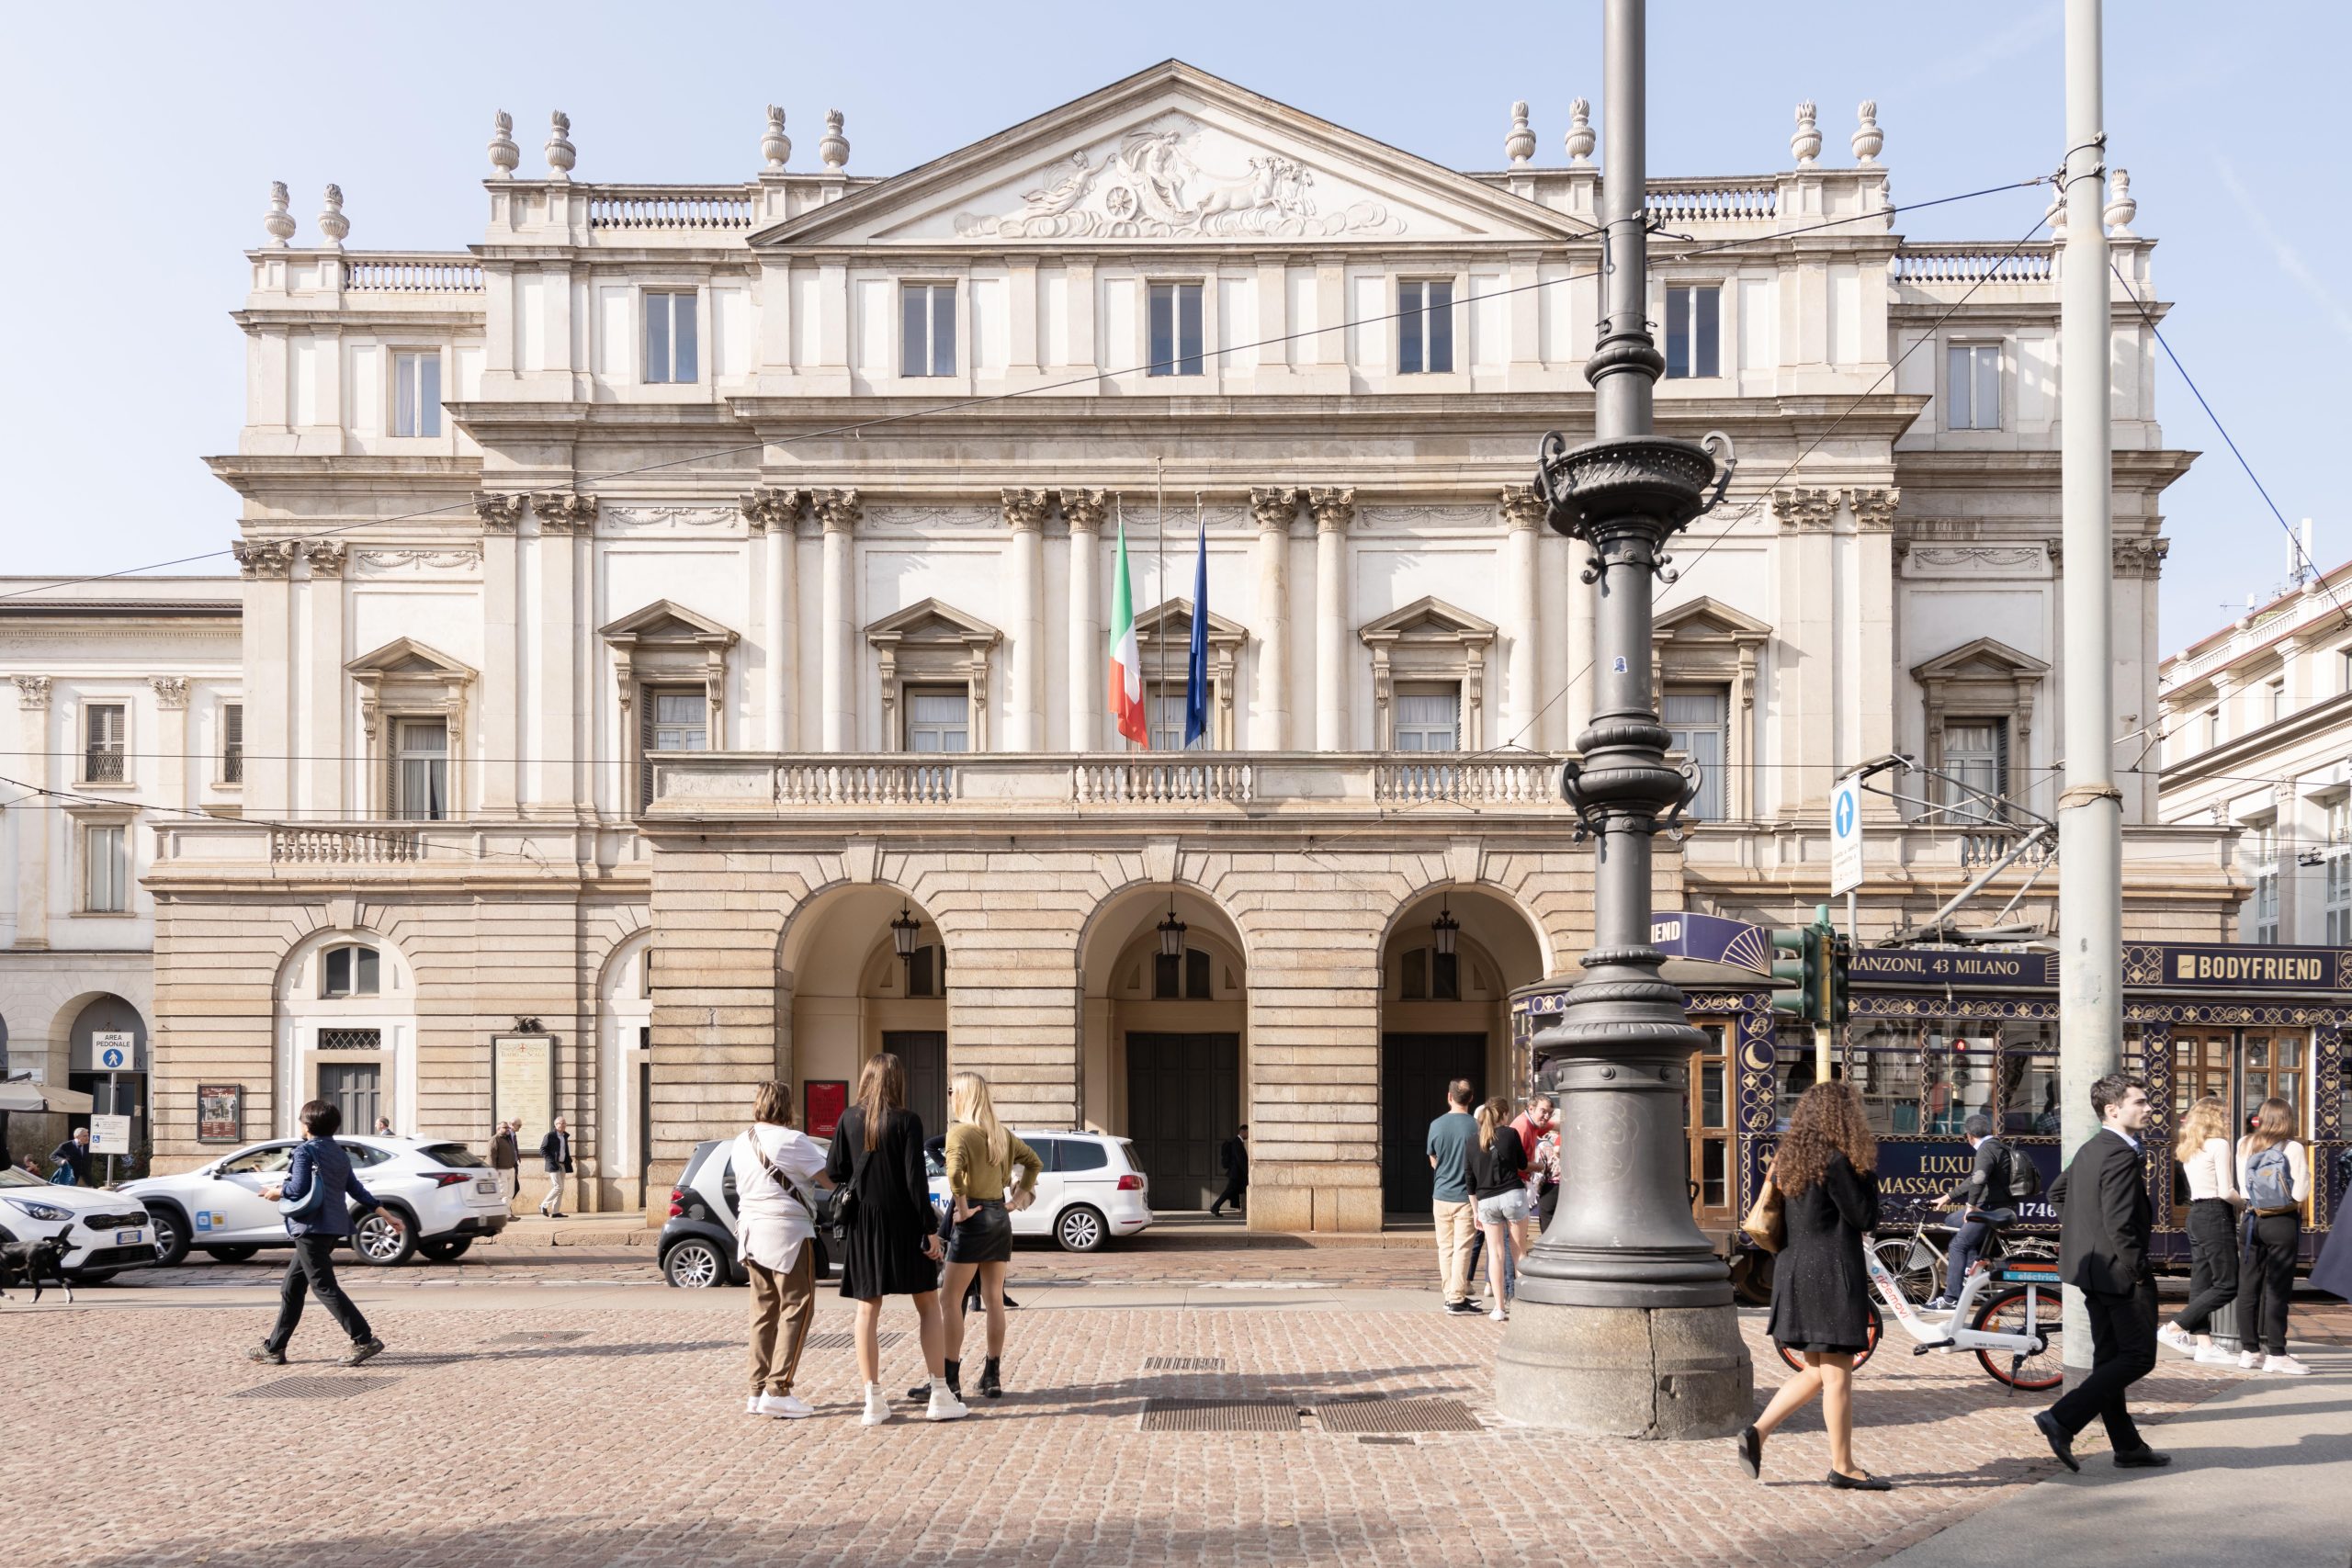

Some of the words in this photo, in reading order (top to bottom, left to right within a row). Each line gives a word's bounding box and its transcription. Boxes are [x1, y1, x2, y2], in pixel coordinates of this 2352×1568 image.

[1651, 920, 1681, 943] IEND
[1848, 956, 1927, 975] MANZONI,
[1932, 959, 1950, 974] 43
[1955, 960, 2019, 976] MILANO
[2199, 955, 2323, 980] BODYFRIEND
[1919, 1155, 1976, 1174] LUXU
[2018, 1202, 2057, 1217] 1746
[1876, 1275, 1912, 1319] ridemovi
